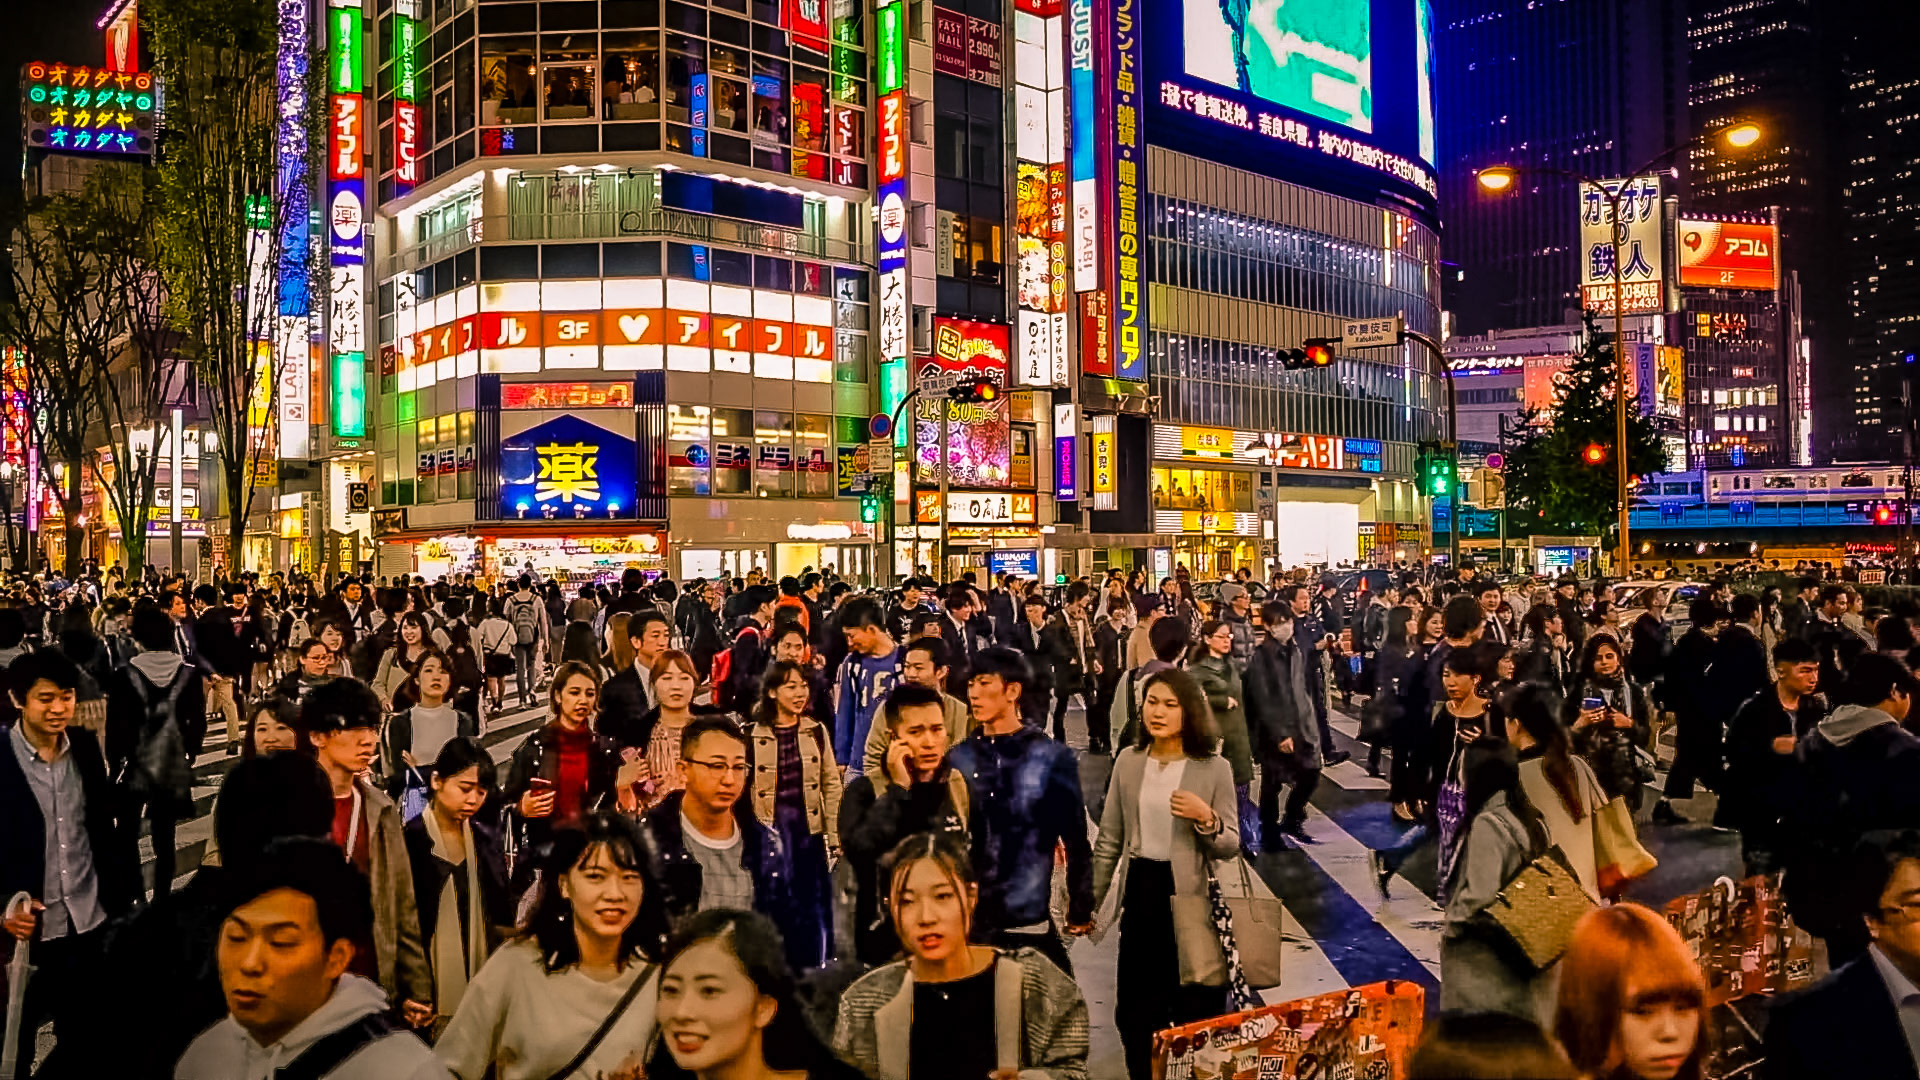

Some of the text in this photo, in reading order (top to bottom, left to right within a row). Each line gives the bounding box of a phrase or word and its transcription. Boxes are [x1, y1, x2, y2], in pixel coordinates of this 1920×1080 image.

[938, 19, 961, 34] FAST
[969, 20, 1000, 39] ネイル
[938, 32, 962, 48] NAIL
[50, 66, 138, 88] オカダヤ
[50, 87, 133, 109] オカダヤ
[50, 108, 133, 131] オカダヤ
[51, 129, 133, 152] オカダヤ
[336, 98, 358, 175] アイフル
[883, 97, 901, 177] アイフル
[1582, 178, 1658, 227] カラオケ
[1082, 225, 1093, 269] LABI
[1724, 237, 1769, 257] アコム
[1589, 240, 1654, 281] 鉄人
[1720, 271, 1735, 283] 2F
[331, 271, 359, 348] 大勝軒
[882, 275, 904, 354] 大勝軒
[558, 319, 589, 340] 3F
[677, 315, 825, 357] アイフル
[285, 356, 296, 398] LABI
[534, 441, 601, 503] 薬
[1062, 440, 1071, 486] PROMISE
[969, 497, 1010, 520] 日高屋
[1016, 496, 1031, 512] 24
[1261, 1056, 1281, 1072] HOT
